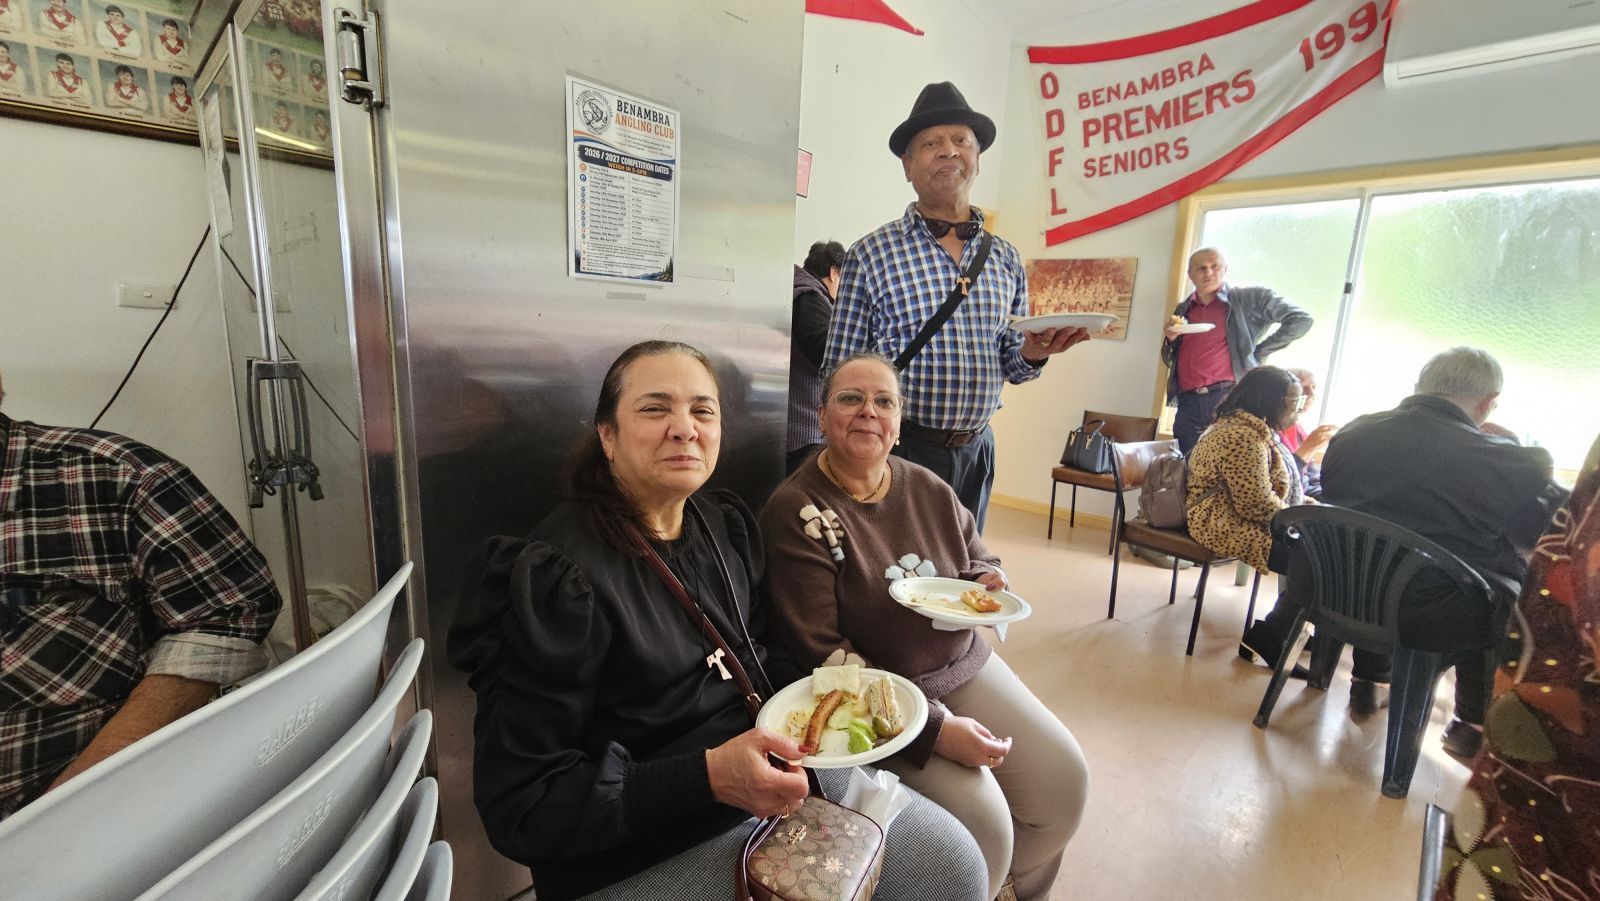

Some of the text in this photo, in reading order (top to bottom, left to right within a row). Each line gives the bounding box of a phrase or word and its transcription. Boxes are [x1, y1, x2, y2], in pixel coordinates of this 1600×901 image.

[1299, 0, 1392, 73] 199
[1078, 53, 1215, 110] BENAMBRA
[616, 99, 671, 126] BENAMBRA
[1082, 68, 1256, 148] PREMIERS
[615, 113, 674, 140] ANGLING CLUB
[608, 161, 625, 171] WEIGH
[620, 156, 654, 172] COMPETITION
[654, 165, 670, 175] DATES
[1083, 136, 1190, 179] SENIORS
